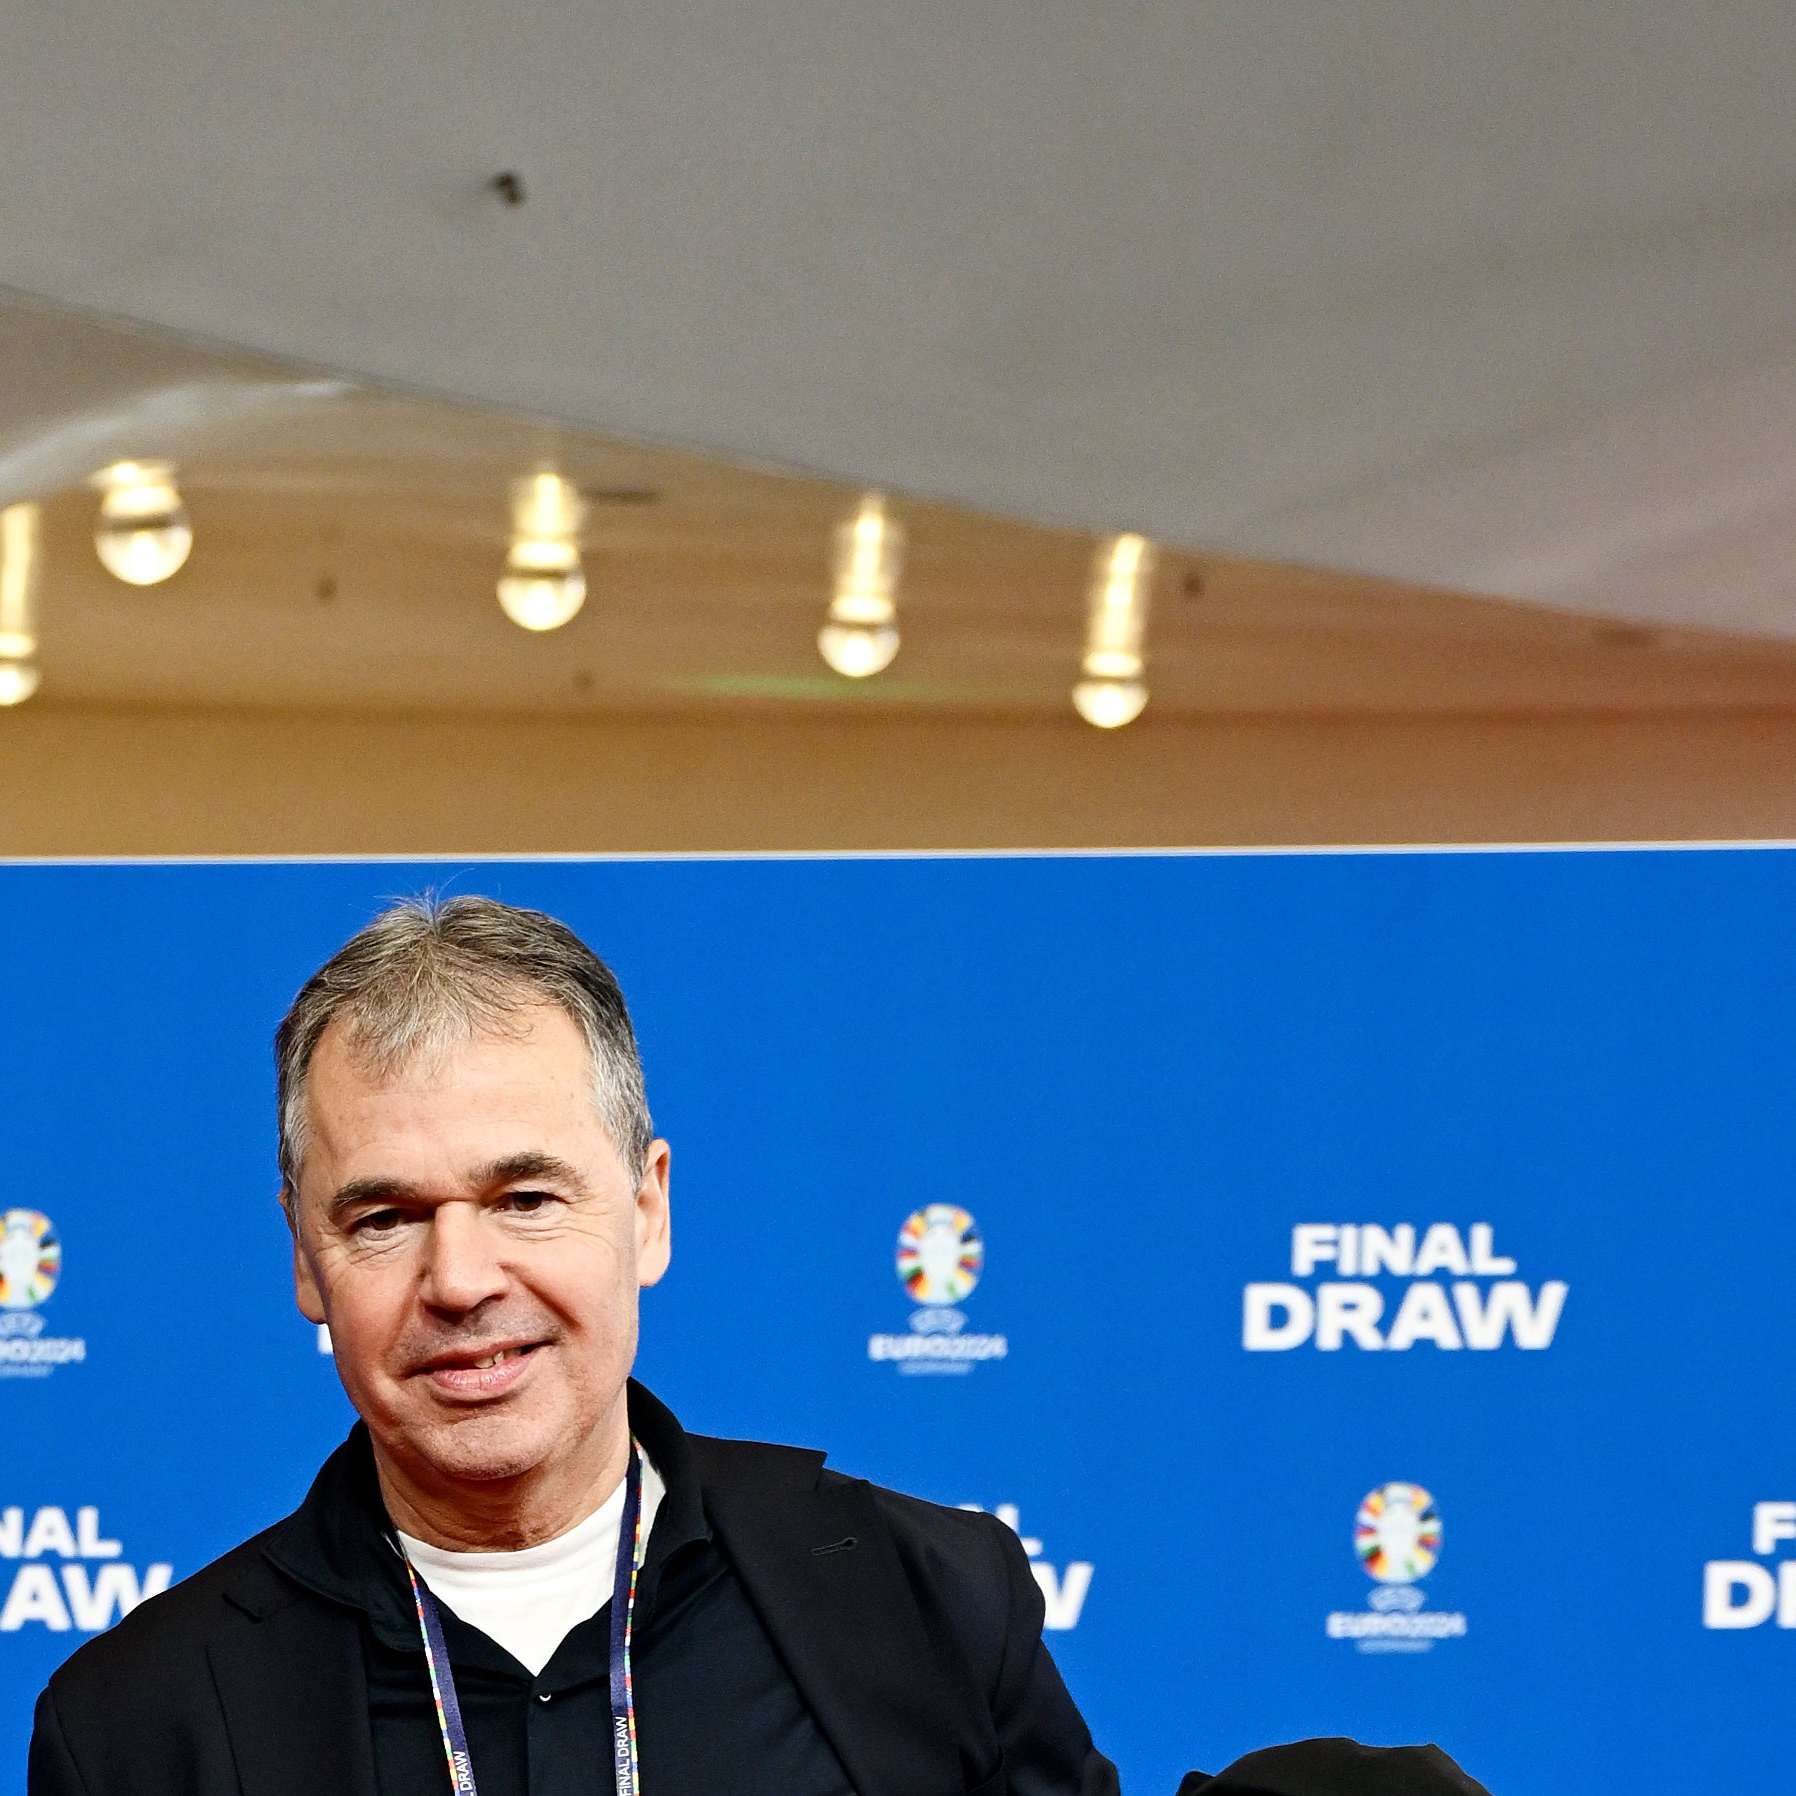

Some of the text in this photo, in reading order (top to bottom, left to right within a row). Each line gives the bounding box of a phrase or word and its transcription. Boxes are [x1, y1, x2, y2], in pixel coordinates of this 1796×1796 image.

[1291, 1222, 1517, 1277] FINAL
[1242, 1281, 1569, 1352] DRAW
[614, 1716, 630, 1757] DRAW
[453, 1751, 475, 1791] DRAW
